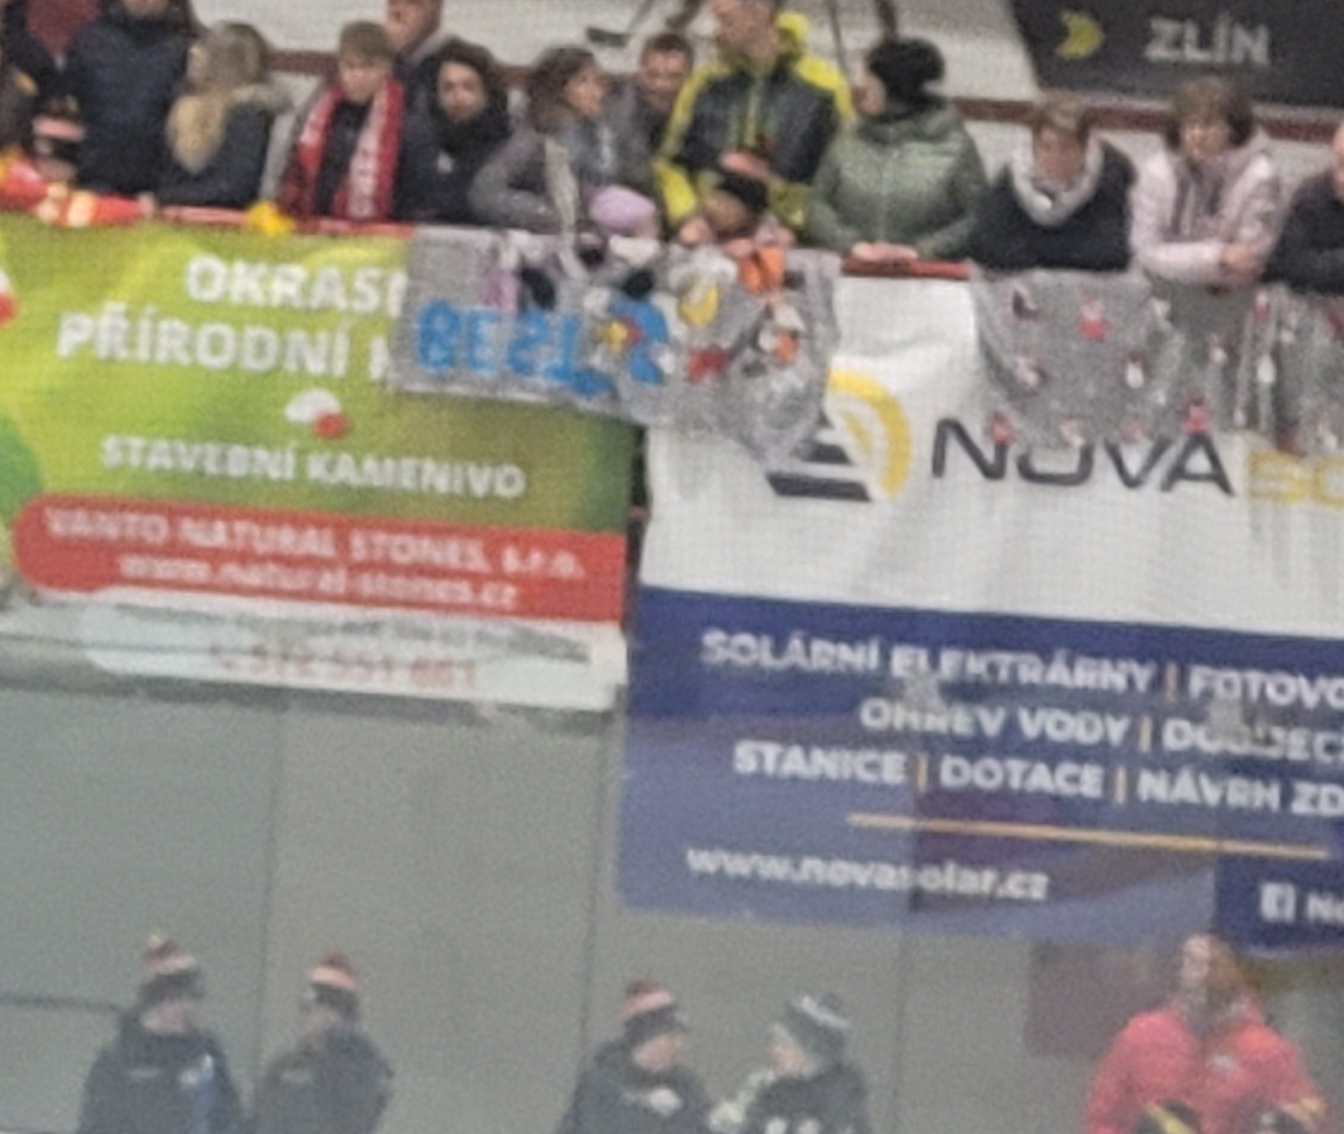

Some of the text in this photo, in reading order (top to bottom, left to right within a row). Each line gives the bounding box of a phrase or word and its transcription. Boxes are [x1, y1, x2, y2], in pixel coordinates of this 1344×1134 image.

[1145, 10, 1270, 66] ZLÍN
[57, 302, 353, 378] PŘÍRODNÍ
[102, 434, 527, 500] STAVEBNÍ KAMENIVO
[179, 514, 338, 560] NATURAL
[702, 630, 879, 670] SOLÁRNÍ
[1018, 707, 1131, 747] VODY
[734, 740, 908, 786] STANICE
[939, 754, 1105, 799] DOTACE
[1137, 764, 1281, 813] NÁVRH
[686, 848, 1049, 902] www.novasolar.cz
